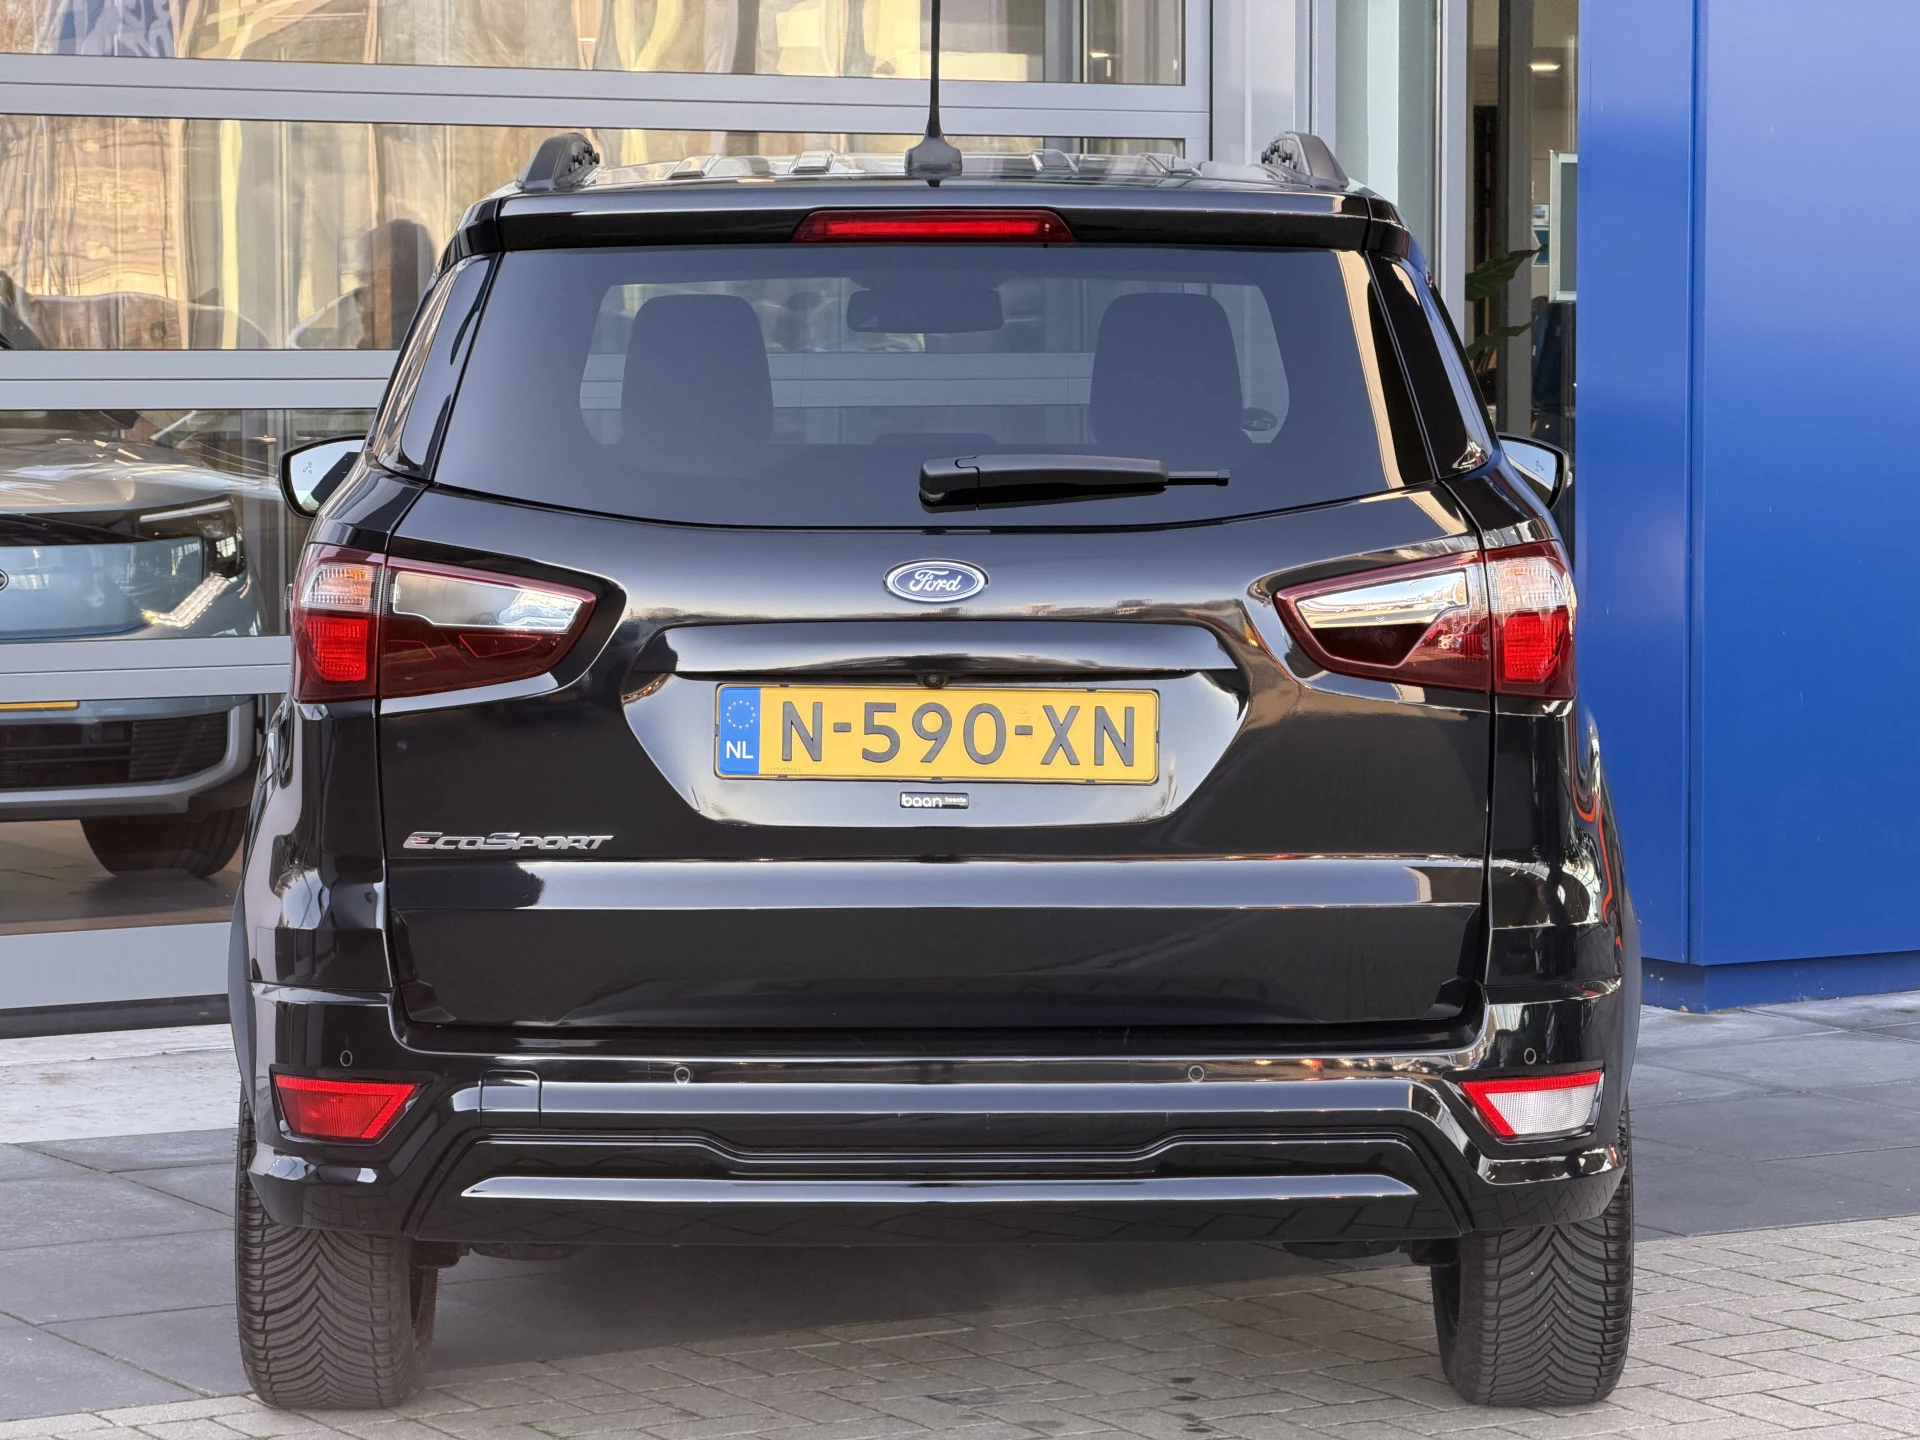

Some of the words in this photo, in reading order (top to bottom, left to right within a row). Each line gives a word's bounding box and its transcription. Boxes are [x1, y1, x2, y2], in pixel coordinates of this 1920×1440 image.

[909, 569, 962, 592] Ford
[781, 701, 1136, 766] N-590-XN
[726, 740, 754, 759] NL
[901, 793, 942, 807] baan
